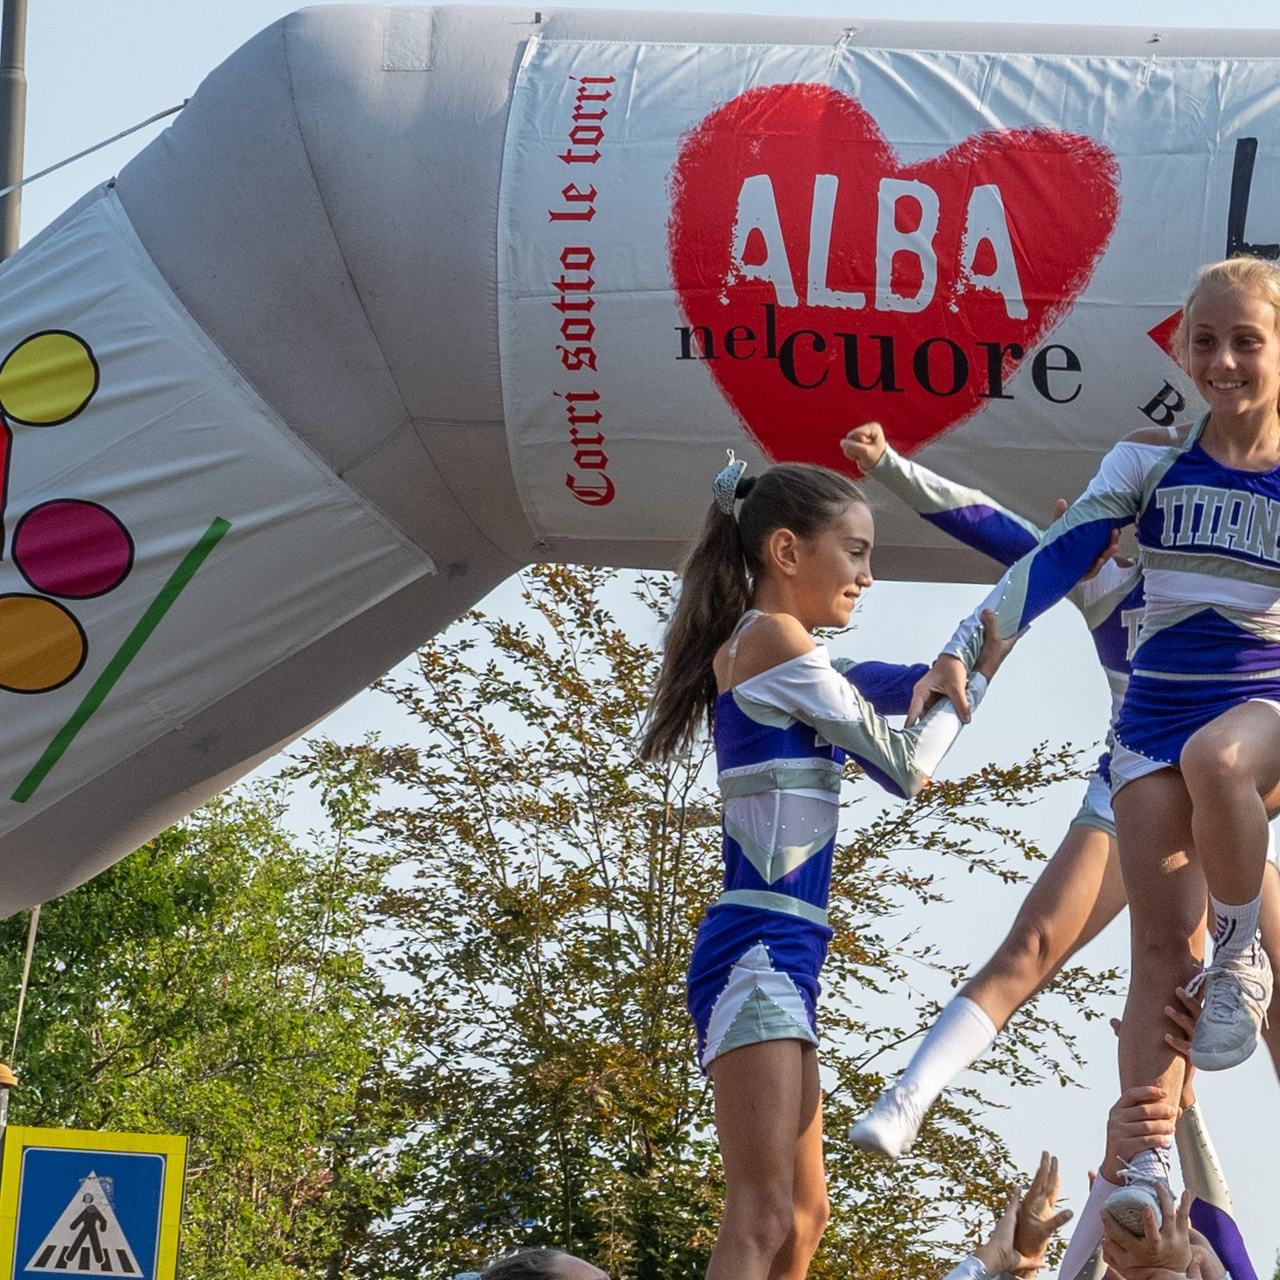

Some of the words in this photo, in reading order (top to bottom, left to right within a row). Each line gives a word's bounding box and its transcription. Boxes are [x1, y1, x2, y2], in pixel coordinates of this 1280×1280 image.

[557, 74, 616, 166] torri
[548, 181, 599, 223] le
[718, 173, 1028, 320] ALBA
[551, 246, 598, 373] sotto
[674, 303, 780, 363] nel
[777, 326, 1084, 404] cuore
[553, 390, 616, 508] Corri
